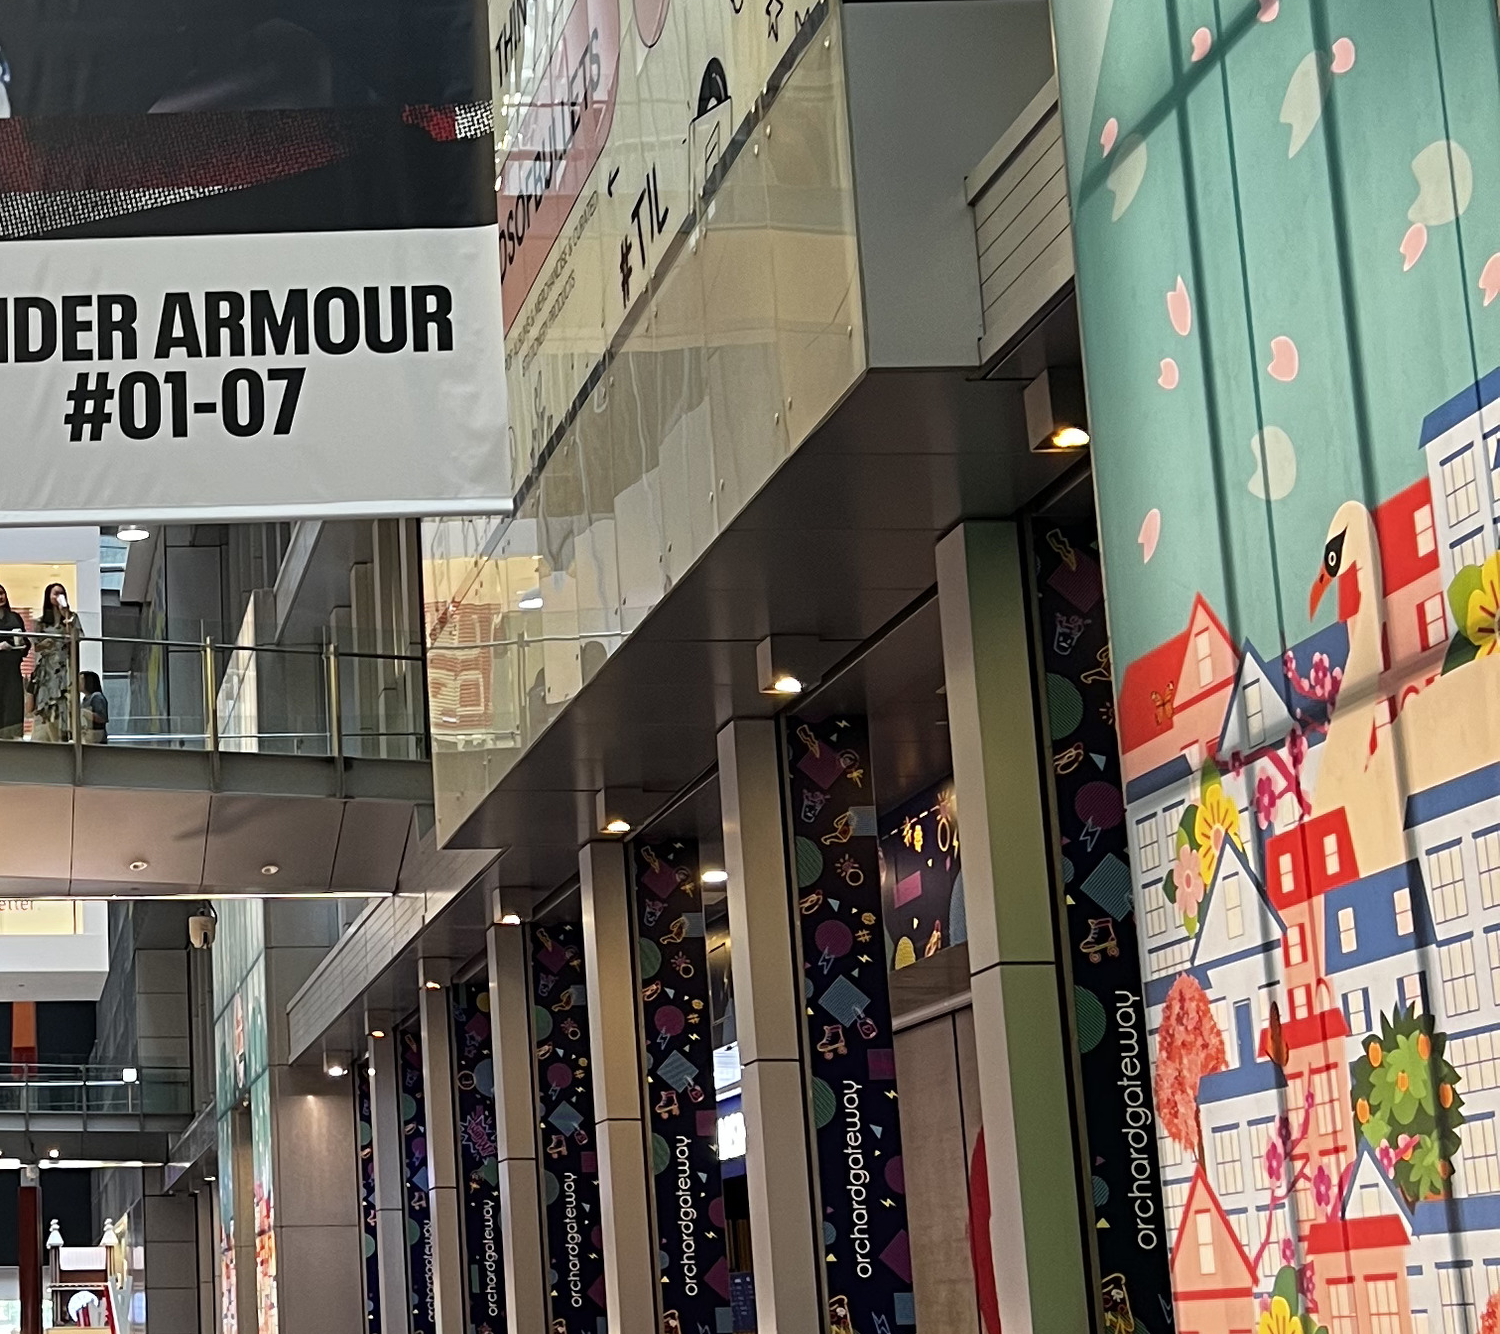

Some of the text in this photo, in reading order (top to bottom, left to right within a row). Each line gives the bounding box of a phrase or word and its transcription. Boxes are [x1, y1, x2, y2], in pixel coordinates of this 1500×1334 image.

[154, 285, 454, 359] ARMOUR
[64, 367, 306, 442] #01-07
[842, 1080, 872, 1278] orchardgateway
[1115, 990, 1157, 1250] orchardgateway
[483, 1199, 498, 1317] orchardgateway
[564, 1172, 582, 1307] orchardgateway
[675, 1135, 698, 1296] orchardgateway
